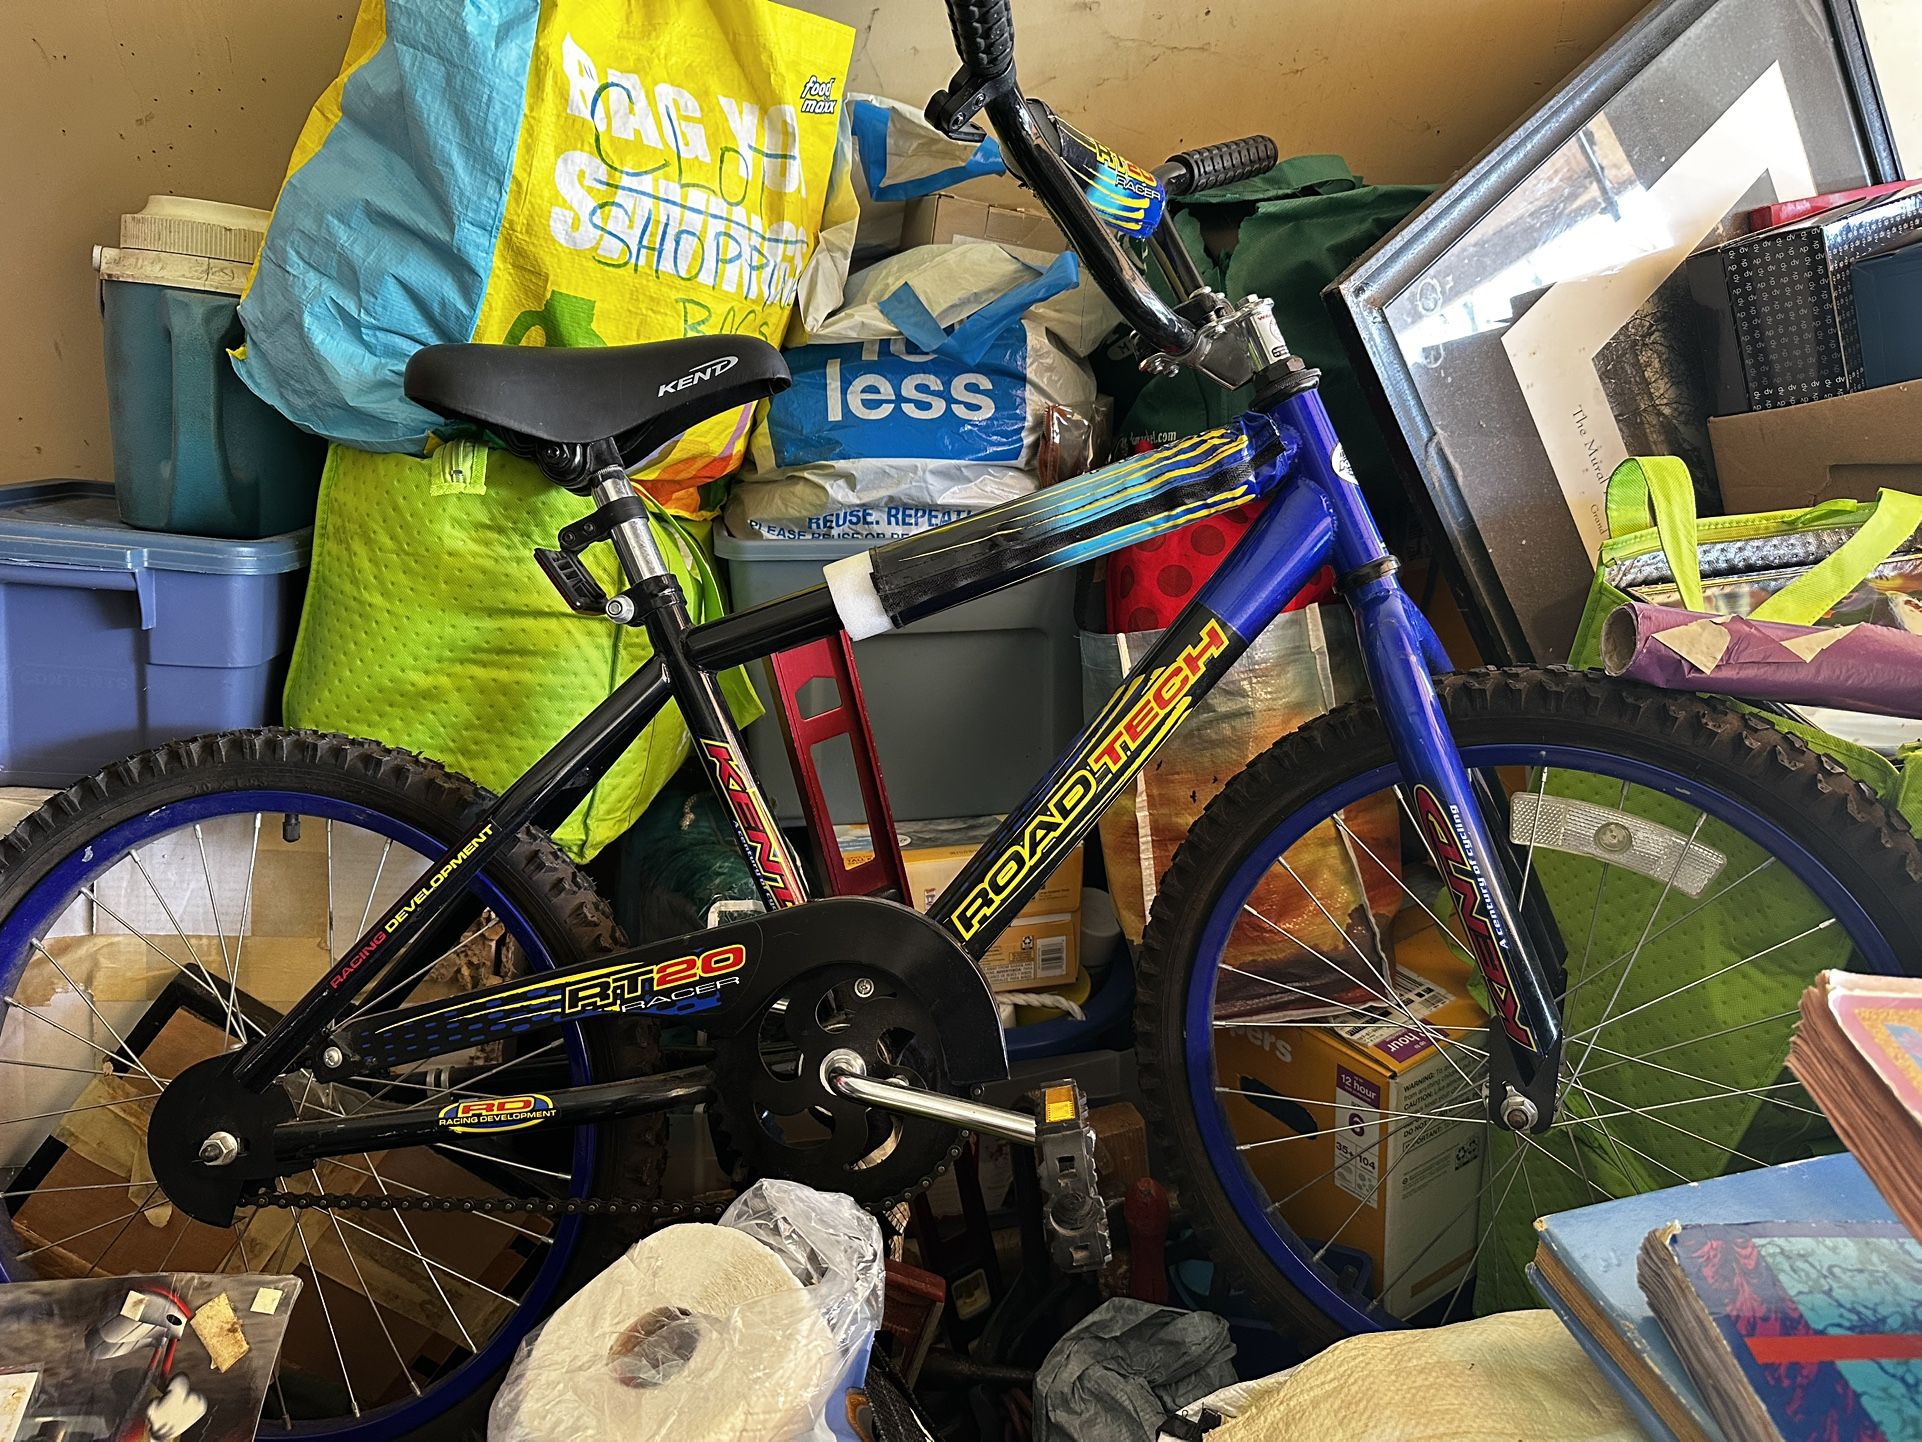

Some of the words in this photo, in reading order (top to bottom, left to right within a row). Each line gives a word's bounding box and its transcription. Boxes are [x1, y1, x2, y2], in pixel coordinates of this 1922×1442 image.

[801, 75, 836, 99] food
[562, 32, 711, 163] BAG
[718, 95, 806, 198] YO
[801, 99, 837, 114] maxx
[1115, 174, 1161, 201] RACER
[657, 356, 739, 397] KENT
[826, 358, 996, 422] less
[1572, 405, 1588, 436] The
[1584, 439, 1610, 485] Mural
[807, 507, 880, 530] REUSE.
[886, 506, 972, 527] REPEAT
[1590, 504, 1607, 535] Grand
[952, 769, 1097, 940] ROAD
[1087, 618, 1229, 774] TECH
[1450, 804, 1474, 858] cycling
[1468, 857, 1480, 875] of
[330, 931, 387, 989] RACING
[384, 823, 493, 934] DEVELOPMENT
[1478, 878, 1506, 935] century
[1499, 938, 1510, 949] A
[566, 945, 746, 1013] RT20
[622, 976, 740, 1013] RACER
[1389, 1032, 1419, 1053] hour
[1340, 1073, 1352, 1087] 12
[1353, 1081, 1377, 1100] hour
[439, 1116, 479, 1126] RACING
[480, 1109, 557, 1123] DEVELOPMENT
[458, 1096, 535, 1117] RD
[1357, 1154, 1376, 1171] 104
